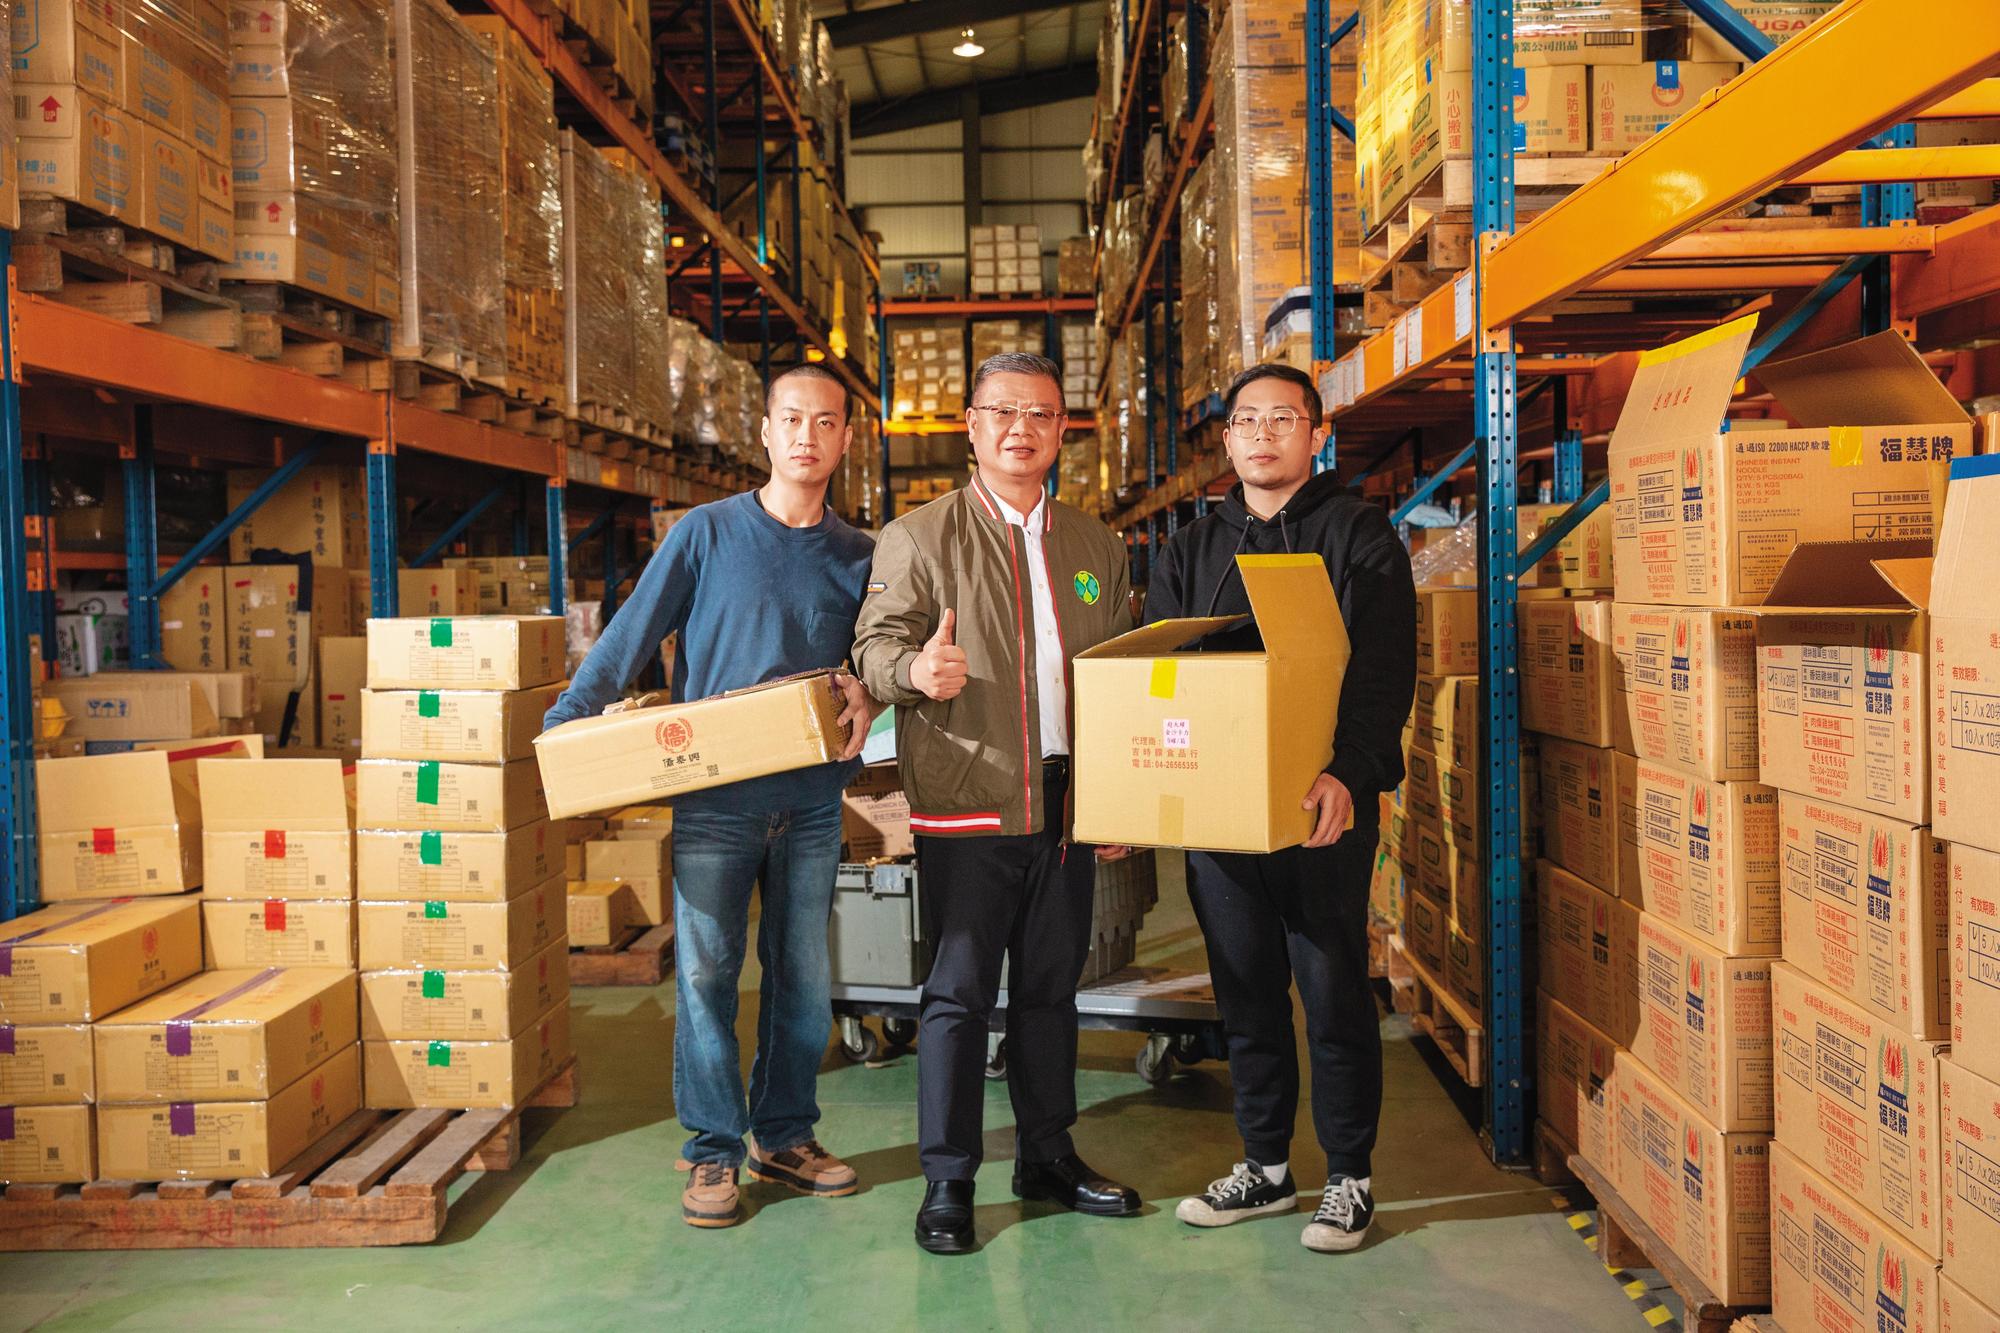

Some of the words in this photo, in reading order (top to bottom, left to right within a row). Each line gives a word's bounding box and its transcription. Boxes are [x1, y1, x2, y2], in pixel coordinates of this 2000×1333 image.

[44, 110, 57, 121] UP
[1446, 88, 1461, 150] 小心搬運
[1566, 82, 1580, 143] 謹防潮濕
[1601, 81, 1614, 142] 小心搬運
[1769, 441, 1788, 452] 22000
[1790, 440, 1809, 452] HACCP
[1811, 439, 1830, 451] 驗證
[1880, 435, 1954, 464] 福慧牌
[1771, 457, 1801, 465] INSTANT
[1683, 502, 1703, 522] 福慧牌
[1952, 665, 1980, 682] 有效期限:
[1865, 690, 1893, 717] 福慧牌
[1867, 893, 1891, 924] 福慧牌
[1879, 1101, 1908, 1138] 福慧牌
